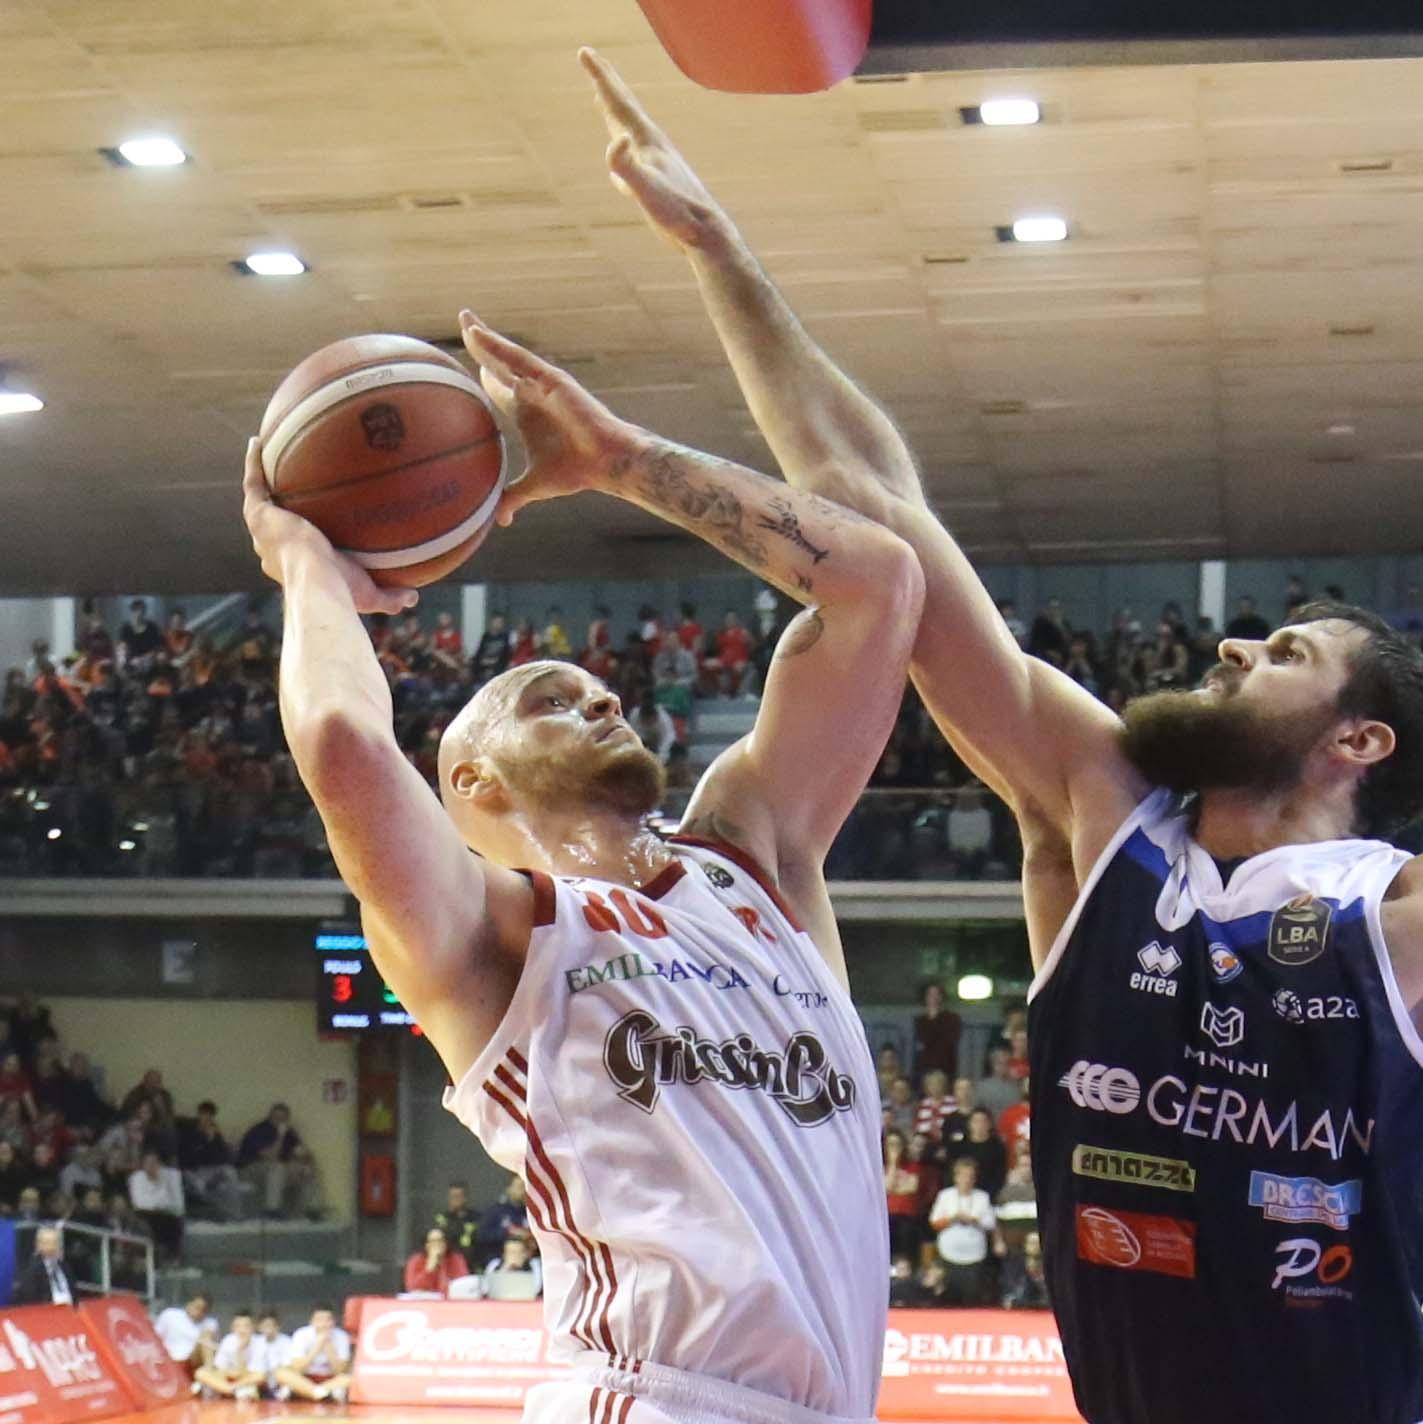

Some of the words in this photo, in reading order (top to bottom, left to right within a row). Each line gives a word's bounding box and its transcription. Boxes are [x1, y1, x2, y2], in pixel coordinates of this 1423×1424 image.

[1277, 926, 1319, 945] LBA
[1129, 971, 1178, 998] errea
[1307, 996, 1360, 1020] a2a
